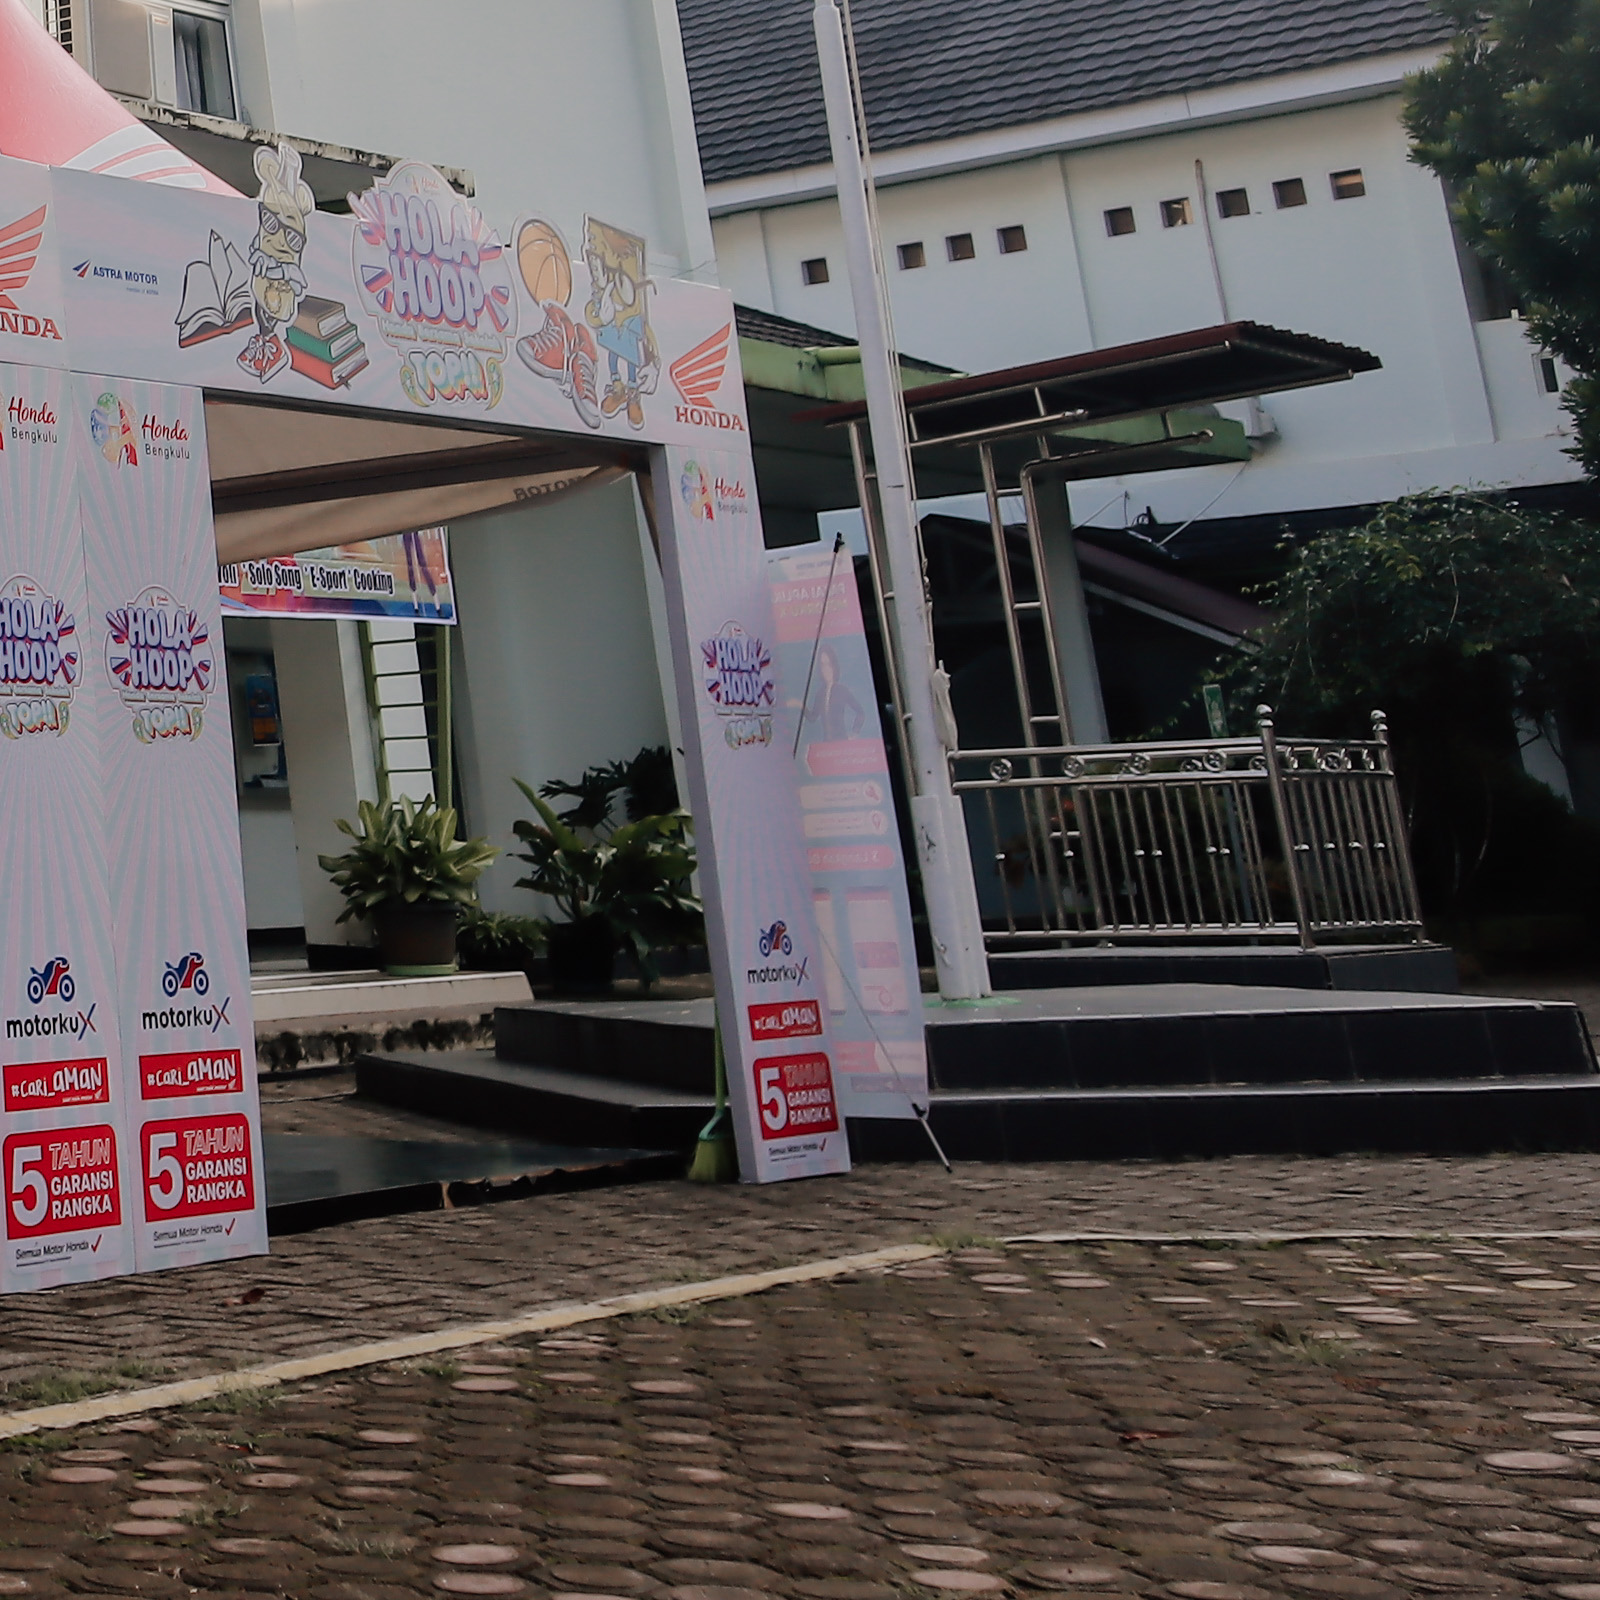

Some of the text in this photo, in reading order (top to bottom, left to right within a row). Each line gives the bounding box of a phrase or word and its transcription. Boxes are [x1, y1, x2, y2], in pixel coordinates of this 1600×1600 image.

[380, 190, 480, 267] HOLA
[93, 266, 158, 285] ASTRA MOTOR
[390, 252, 486, 331] HOOP
[8, 397, 58, 424] Honda
[675, 406, 746, 432] HONDA
[12, 427, 58, 444] Bengkulu
[142, 414, 190, 441] Honda
[145, 443, 190, 460] Bengkulu
[714, 477, 746, 500] Honda
[250, 563, 393, 595] Solo Song E-Sport Cooking
[127, 607, 192, 650] HOLA
[130, 647, 194, 692] HOOP
[717, 638, 761, 674] HOLA
[720, 671, 763, 707] HOOP
[761, 1067, 788, 1131] 5
[789, 1105, 832, 1126] RANGKA
[149, 1125, 245, 1210] 5 TAHUN
[186, 1156, 247, 1181] GARANSI
[11, 1138, 111, 1227] 5 TAHUN
[51, 1172, 114, 1196] GARANSI
[187, 1181, 246, 1205] RANGKA
[52, 1195, 114, 1220] RANGKA
